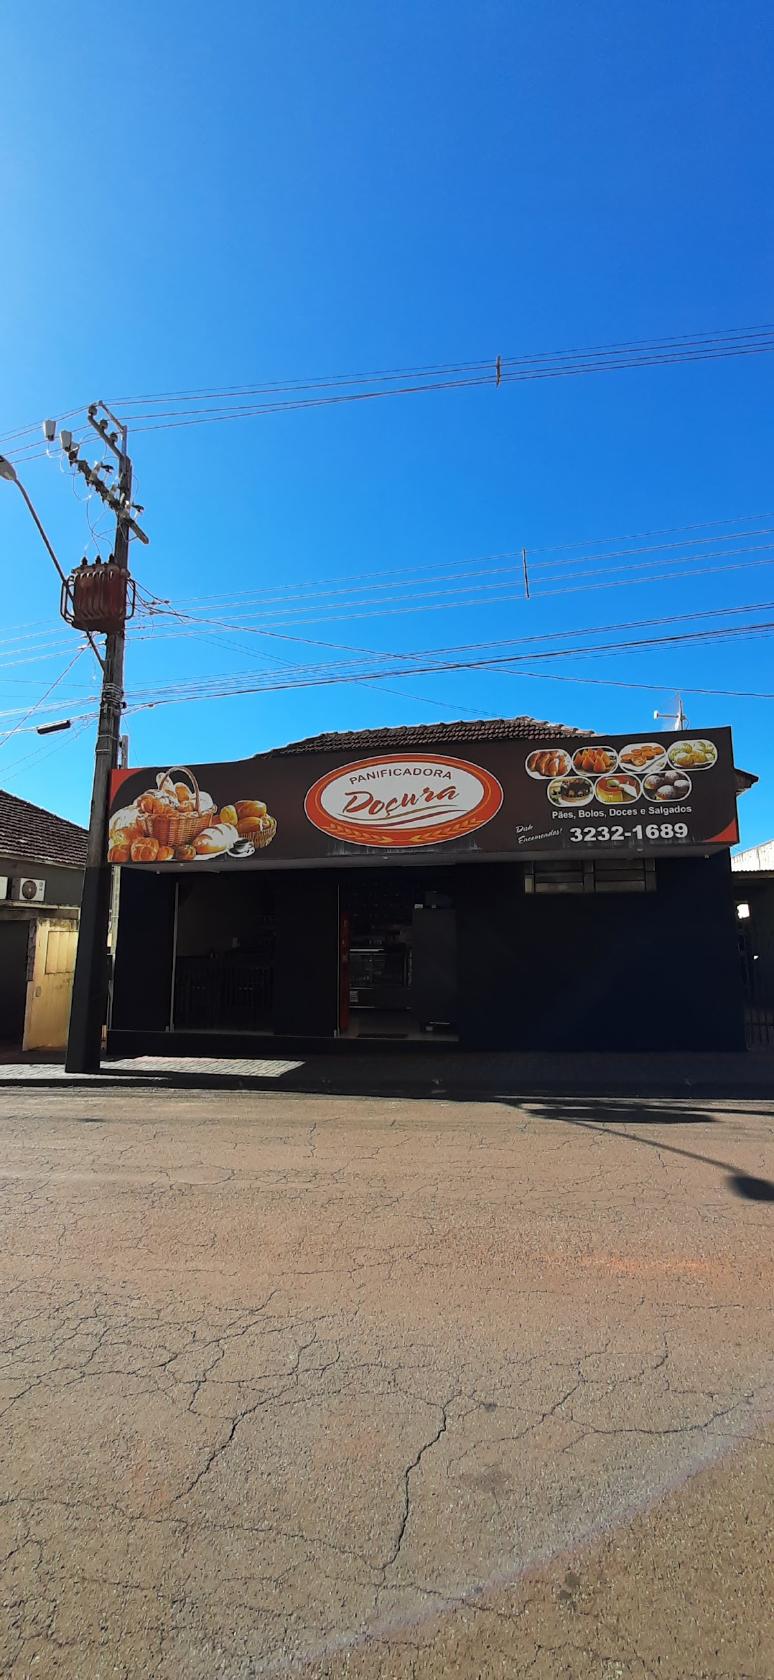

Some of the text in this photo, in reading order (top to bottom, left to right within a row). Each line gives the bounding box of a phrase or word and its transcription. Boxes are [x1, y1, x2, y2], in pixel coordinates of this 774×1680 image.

[349, 767, 453, 785] PANIFICADORA
[342, 785, 460, 817] Doçura
[551, 810, 576, 820] Pães,
[578, 809, 607, 819] Bolos,
[609, 807, 638, 817] Doces
[648, 805, 692, 816] Salgados
[569, 822, 689, 842] 3232-1689
